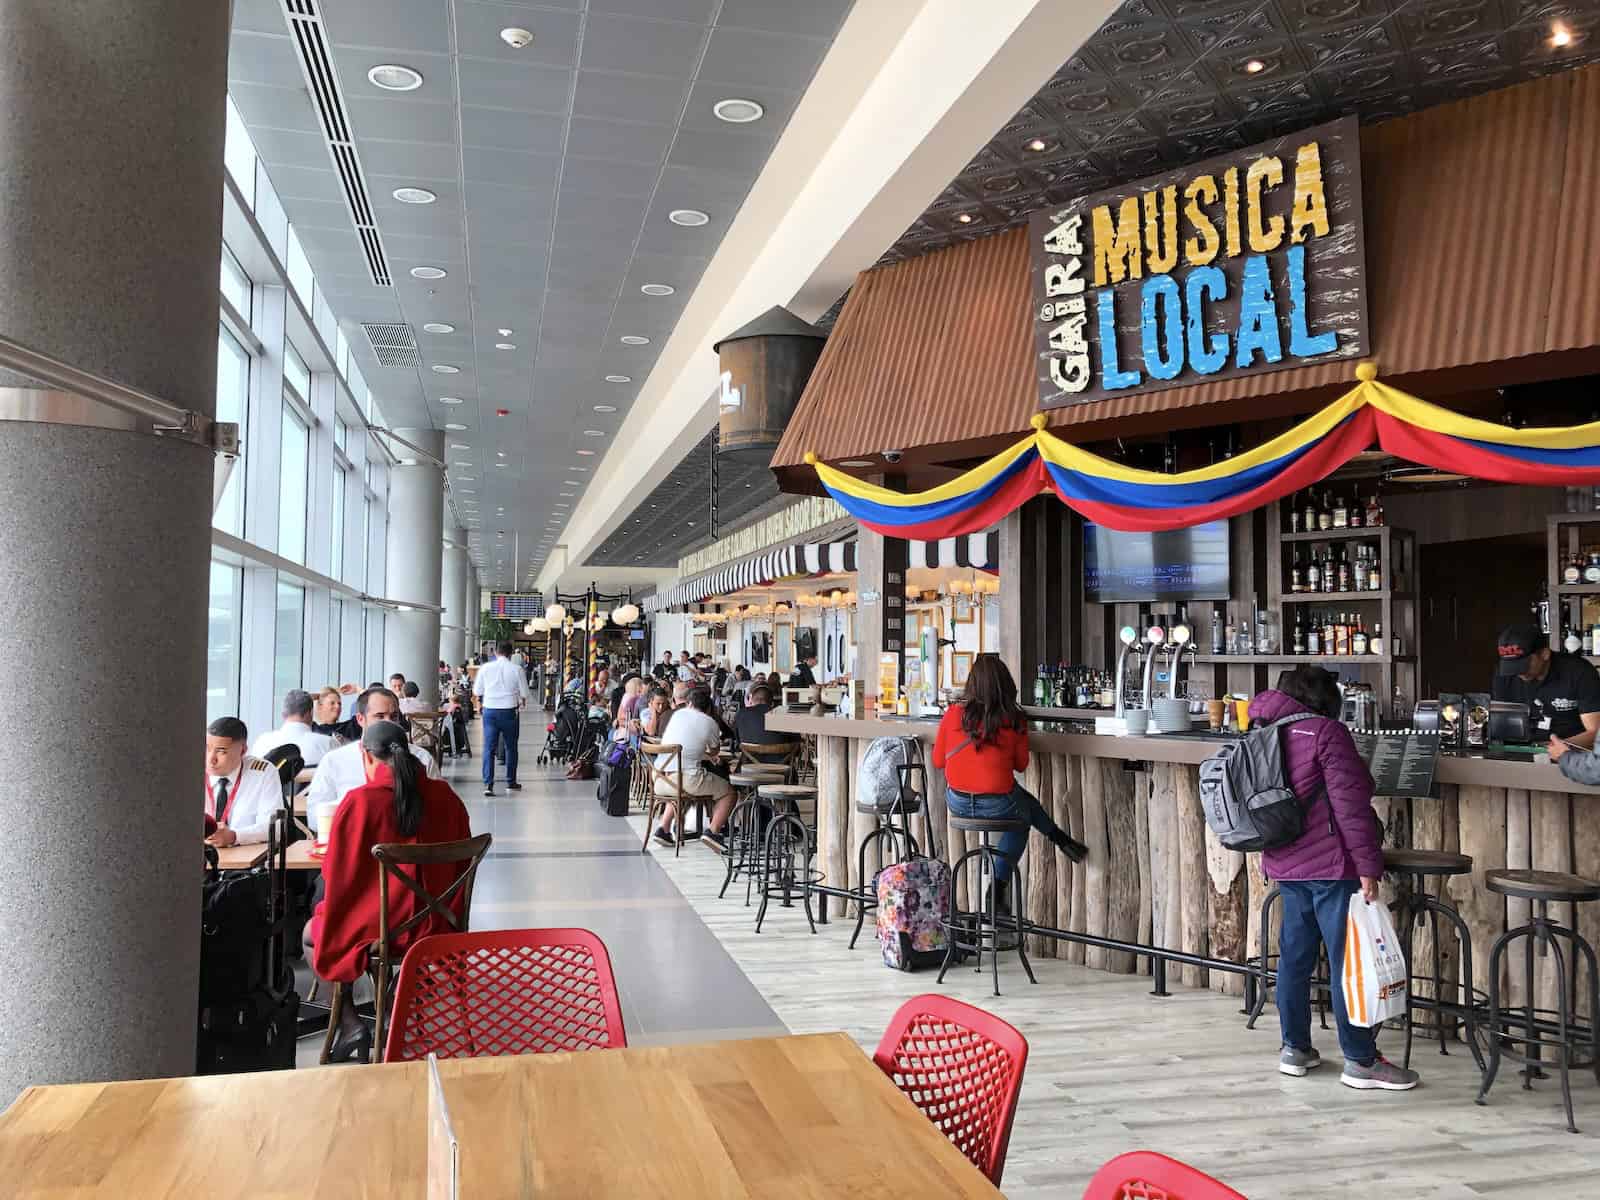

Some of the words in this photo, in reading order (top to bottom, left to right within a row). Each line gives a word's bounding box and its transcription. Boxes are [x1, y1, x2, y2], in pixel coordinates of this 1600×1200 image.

[1092, 142, 1330, 287] MUSICA
[1097, 246, 1338, 391] LOCAL
[785, 498, 810, 538] SABOR
